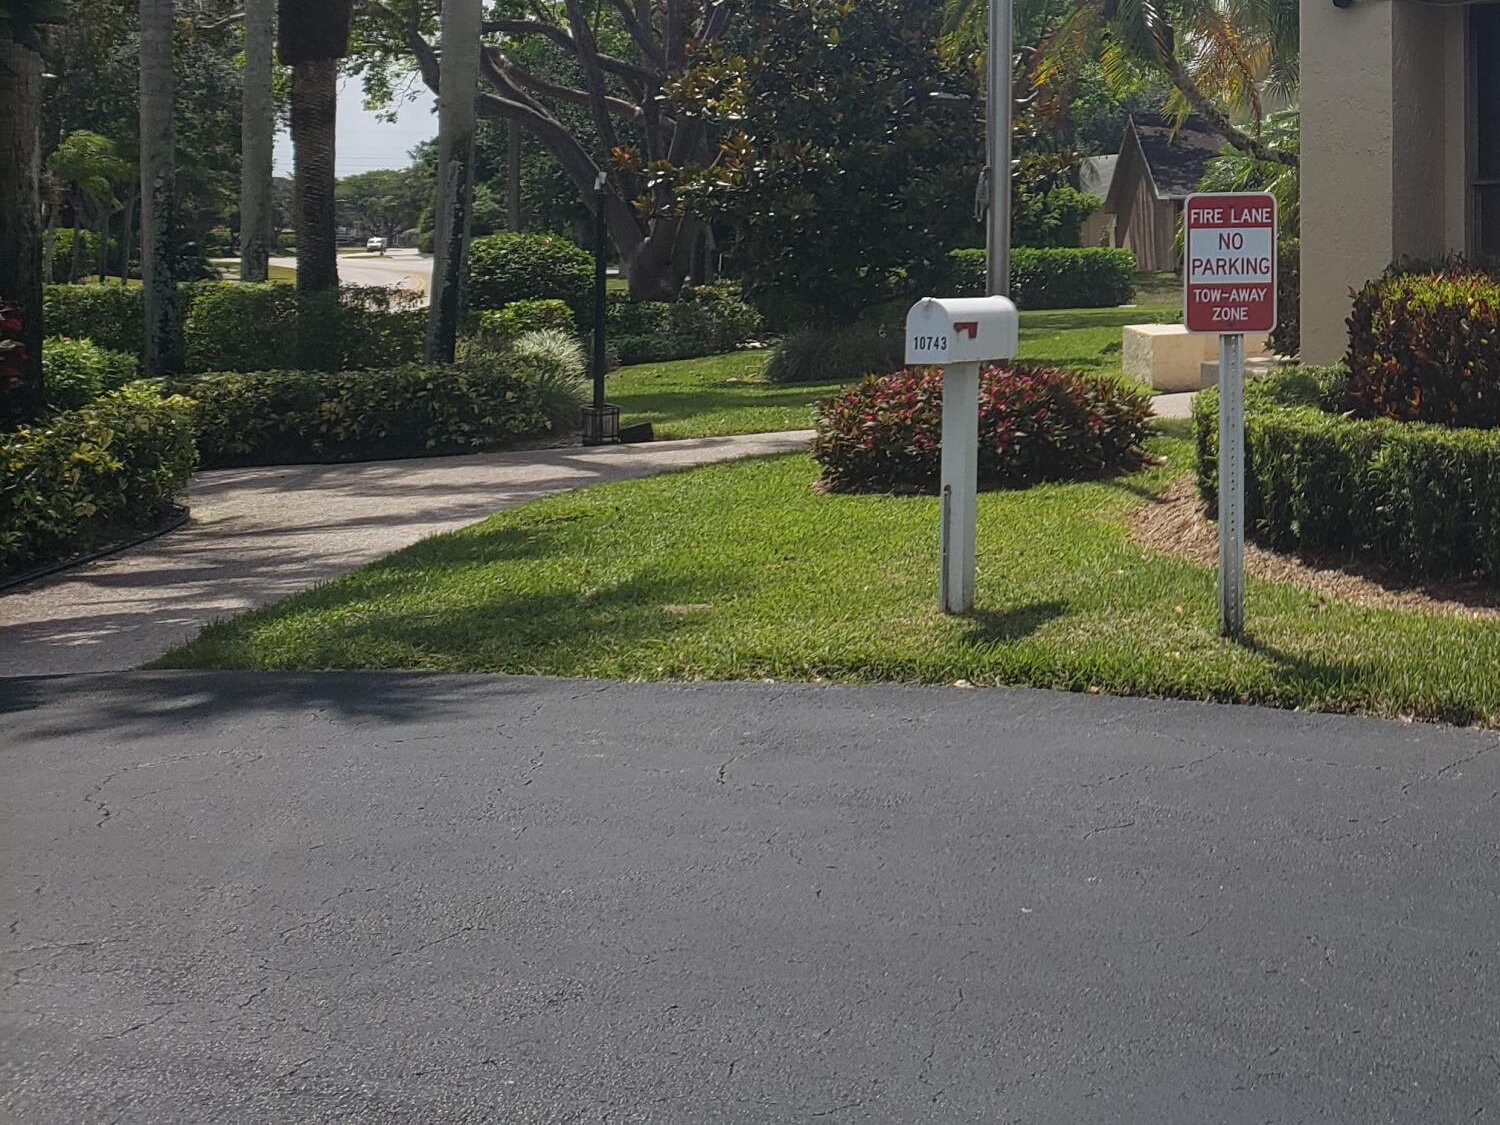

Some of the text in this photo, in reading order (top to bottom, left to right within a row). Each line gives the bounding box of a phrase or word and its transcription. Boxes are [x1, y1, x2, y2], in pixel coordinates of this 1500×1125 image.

[1190, 208, 1271, 224] FIRE LANE
[1218, 233, 1243, 250] NO
[1192, 258, 1270, 275] PARKING
[1194, 288, 1267, 303] TOW-AWAY
[1212, 307, 1248, 321] ZONE
[914, 336, 947, 350] 10743
